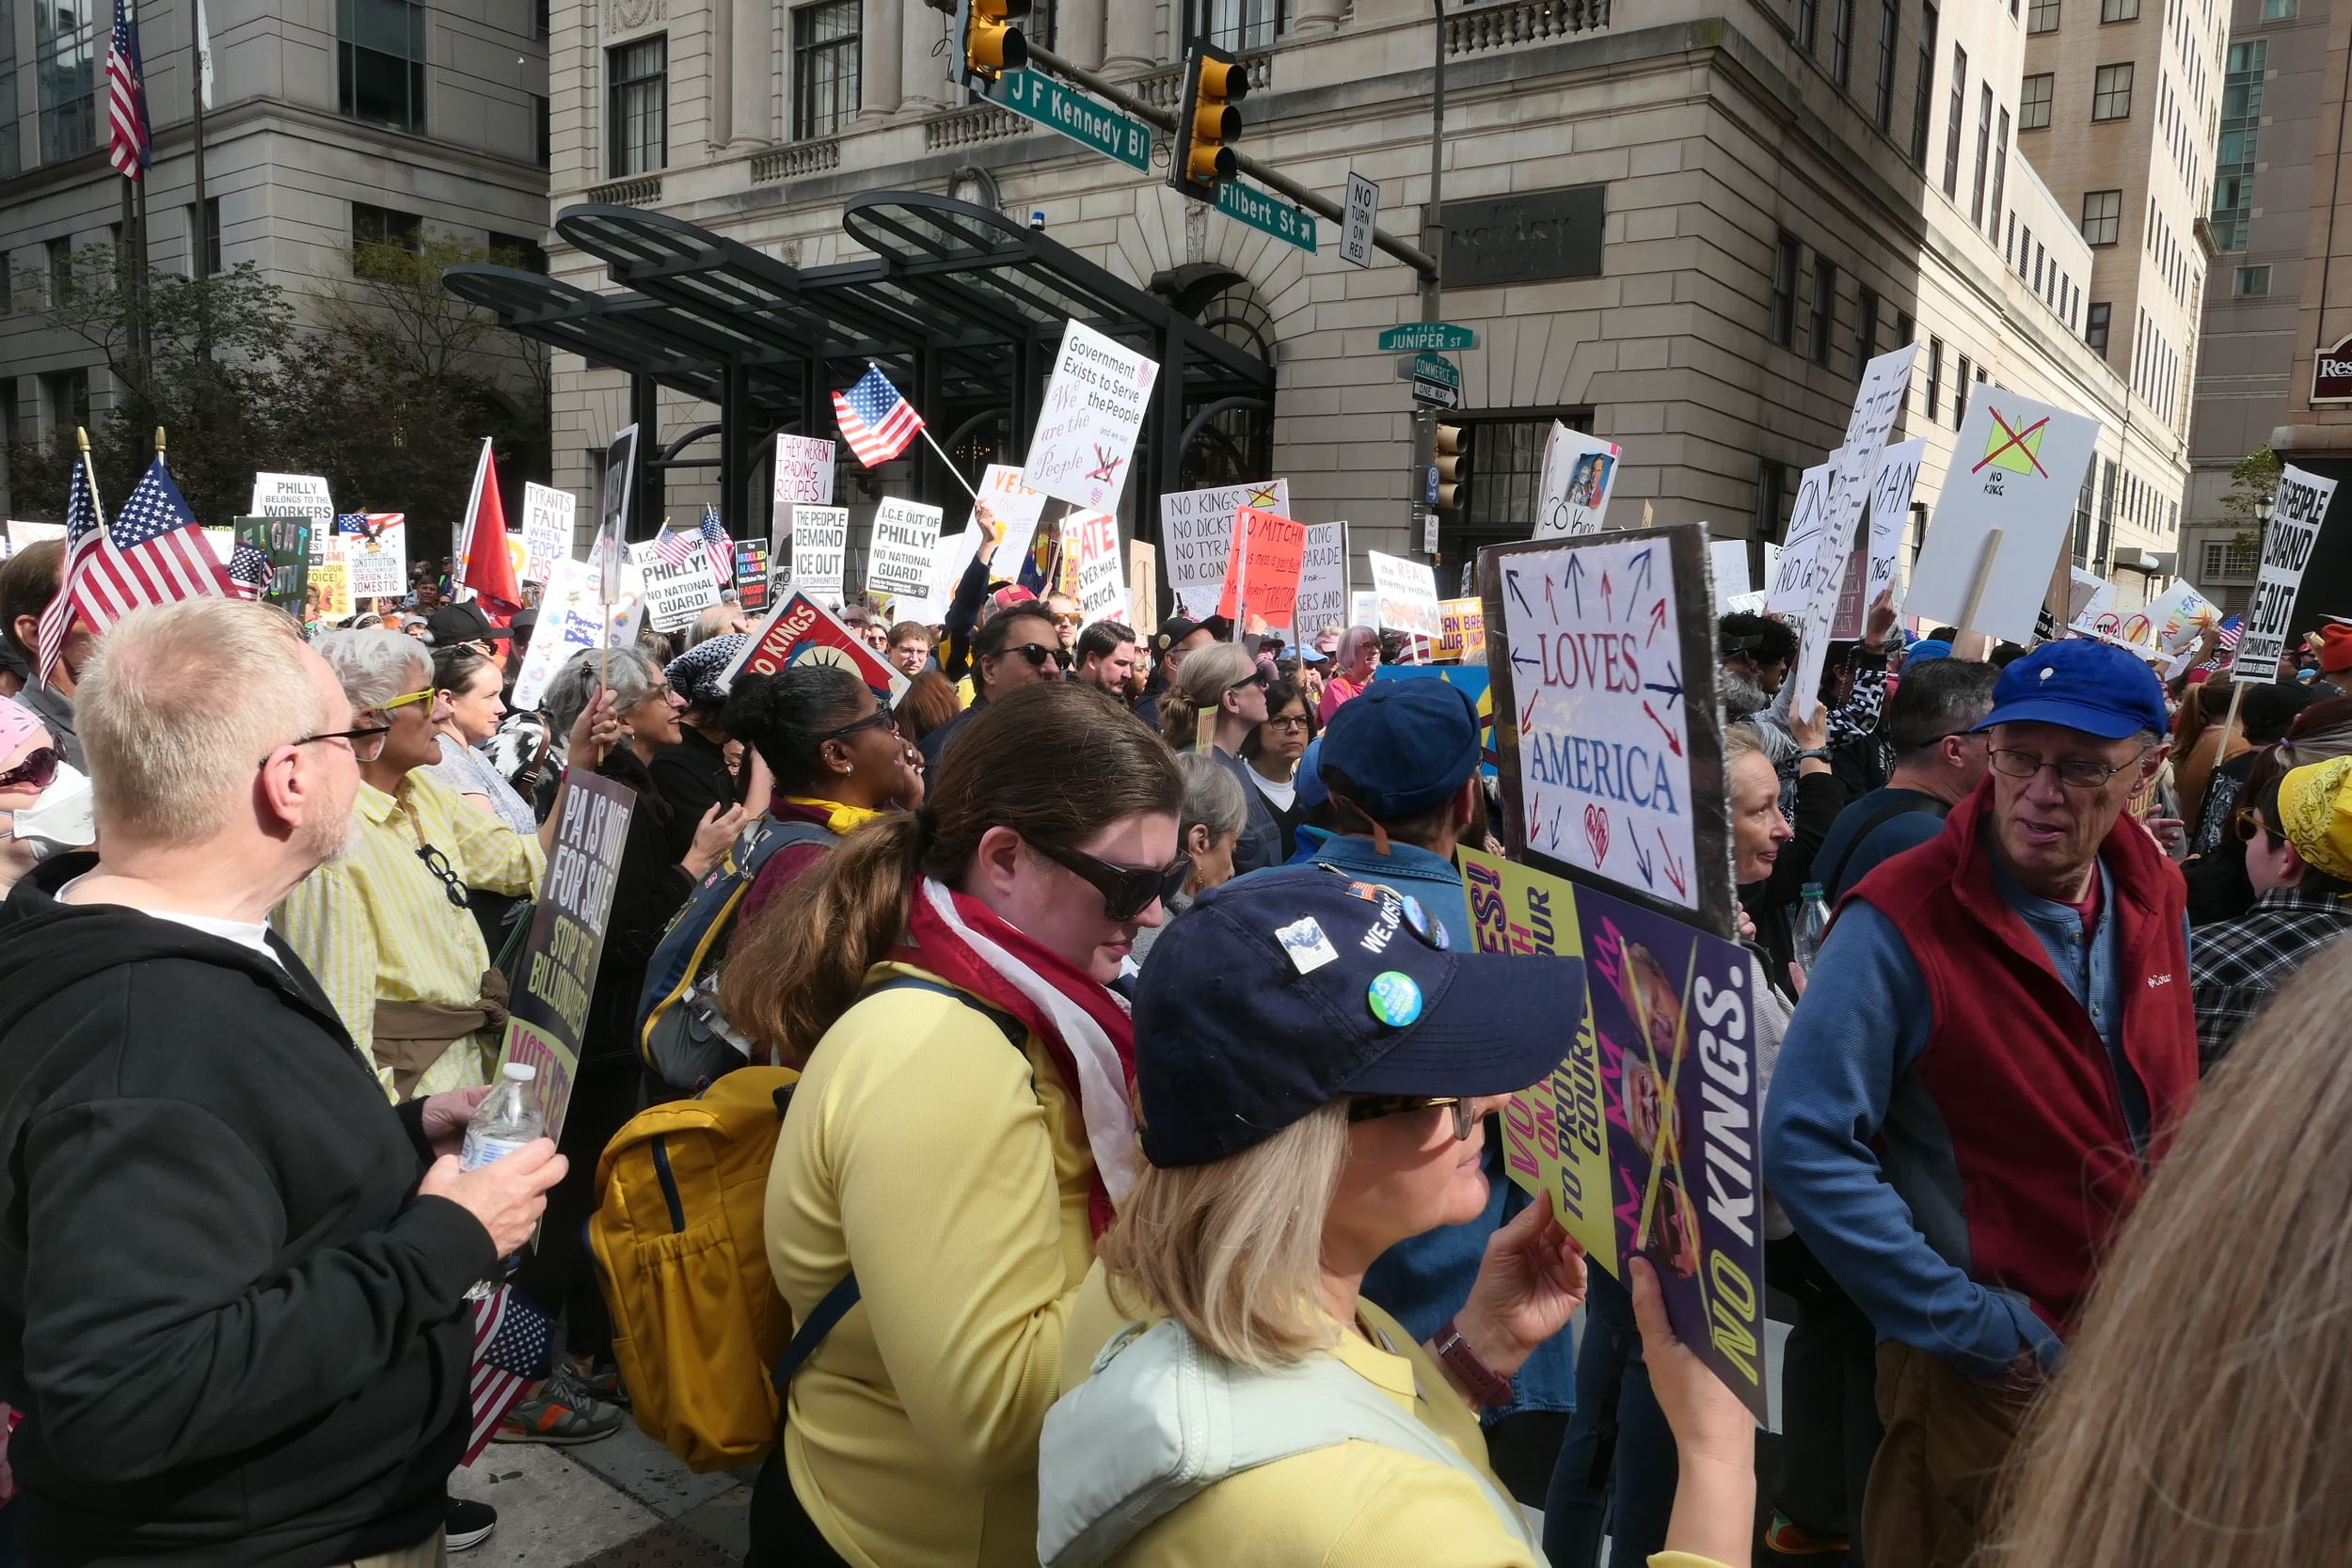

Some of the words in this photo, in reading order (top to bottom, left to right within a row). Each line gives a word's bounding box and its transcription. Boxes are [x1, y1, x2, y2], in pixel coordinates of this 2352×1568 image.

[1012, 73, 1024, 100] J
[1033, 80, 1043, 108] F
[1052, 88, 1121, 153] Kennedy
[1355, 183, 1372, 206] NO
[1220, 183, 1272, 227] Filbert
[1279, 210, 1295, 236] St
[1351, 205, 1370, 225] TURN
[1353, 225, 1364, 241] ON
[1349, 242, 1364, 260] RED
[1390, 334, 1444, 349] JUNIPER
[1451, 338, 1462, 347] ST
[1069, 336, 1136, 380] Government
[1063, 356, 1097, 385] Exists
[1099, 373, 1111, 391] to
[1112, 377, 1139, 404] Serve
[1416, 358, 1451, 383] COMMERCE
[1452, 375, 1458, 386] ST
[1052, 380, 1080, 412] We
[1419, 384, 1432, 396] ONE
[1435, 388, 1447, 401] WAY
[1088, 391, 1105, 411] the
[1105, 402, 1140, 425] People
[1041, 423, 1065, 442] are
[1068, 407, 1089, 434] the
[779, 436, 802, 459] THEY
[777, 460, 818, 480] TRADING
[1035, 444, 1083, 483] People
[1989, 471, 2002, 482] NO
[265, 496, 301, 504] BELONGS
[304, 496, 313, 504] TO
[278, 482, 317, 495] PHILLY
[528, 485, 571, 512] TYRANTS
[1983, 483, 2004, 496] KINGS
[264, 505, 331, 519] WORKERS
[1171, 497, 1191, 516] NO
[1199, 491, 1240, 514] KINGS
[2289, 482, 2328, 525] PEOPLE
[533, 507, 567, 531] FALL
[796, 511, 809, 527] THE
[811, 513, 845, 528] PEOPLE
[882, 506, 903, 521] I.C.E
[906, 512, 925, 525] OUT
[927, 516, 941, 528] OF
[529, 526, 561, 543] WHEN
[796, 529, 843, 547] DEMAND
[878, 523, 936, 550] PHILLY!
[1172, 520, 1192, 539] NO
[1308, 526, 1332, 545] KING
[527, 537, 564, 560] PEOPLE
[873, 548, 886, 560] NO
[888, 551, 931, 568] NATIONAL
[1175, 545, 1194, 560] NO
[1197, 540, 1231, 559] TYRA
[1235, 549, 1254, 565] TIS
[1303, 546, 1341, 565] PARADE
[528, 557, 551, 580] RIS
[642, 554, 708, 584] PHILLY!
[739, 562, 767, 574] MASSES
[797, 553, 814, 575] ICE
[816, 554, 841, 575] OUT
[878, 562, 923, 582] GUARD!
[1079, 566, 1099, 590] EVER
[1101, 557, 1118, 575] MADE
[1178, 565, 1195, 580] NO
[1381, 564, 1394, 577] the
[1398, 562, 1427, 584] REAL
[310, 573, 338, 582] OICE!
[353, 573, 381, 581] OREIGN
[1379, 578, 1406, 593] enemy
[1407, 583, 1433, 597] within
[647, 590, 662, 601] NO
[664, 578, 714, 597] NATIONAL
[1083, 582, 1116, 614] MERICA
[1265, 587, 1295, 610] TRAITOR
[1297, 594, 1319, 611] SERS
[1322, 591, 1341, 609] AND
[659, 594, 710, 614] GUARD!
[2266, 583, 2296, 636] OUT
[762, 604, 818, 659] KINGS
[1464, 614, 1484, 631] BREA
[1538, 632, 1641, 695] LOVES
[1530, 731, 1679, 816] AMERICA
[564, 784, 589, 840] PA
[589, 795, 606, 855] IS
[605, 800, 631, 868] NOT
[548, 845, 584, 917] FOR
[581, 860, 612, 937] SALE
[1466, 861, 1513, 957] ES!
[1359, 922, 1393, 954] WE
[550, 914, 580, 968] STOP
[574, 930, 594, 986] THE
[1572, 999, 1600, 1156] COURT
[1553, 1048, 1581, 1165] PROT
[1693, 966, 1756, 1246] KINGS.
[1505, 1092, 1540, 1180] VO
[1534, 1098, 1559, 1161] ON
[1562, 1166, 1583, 1221] TO
[1710, 1248, 1758, 1386] NO
